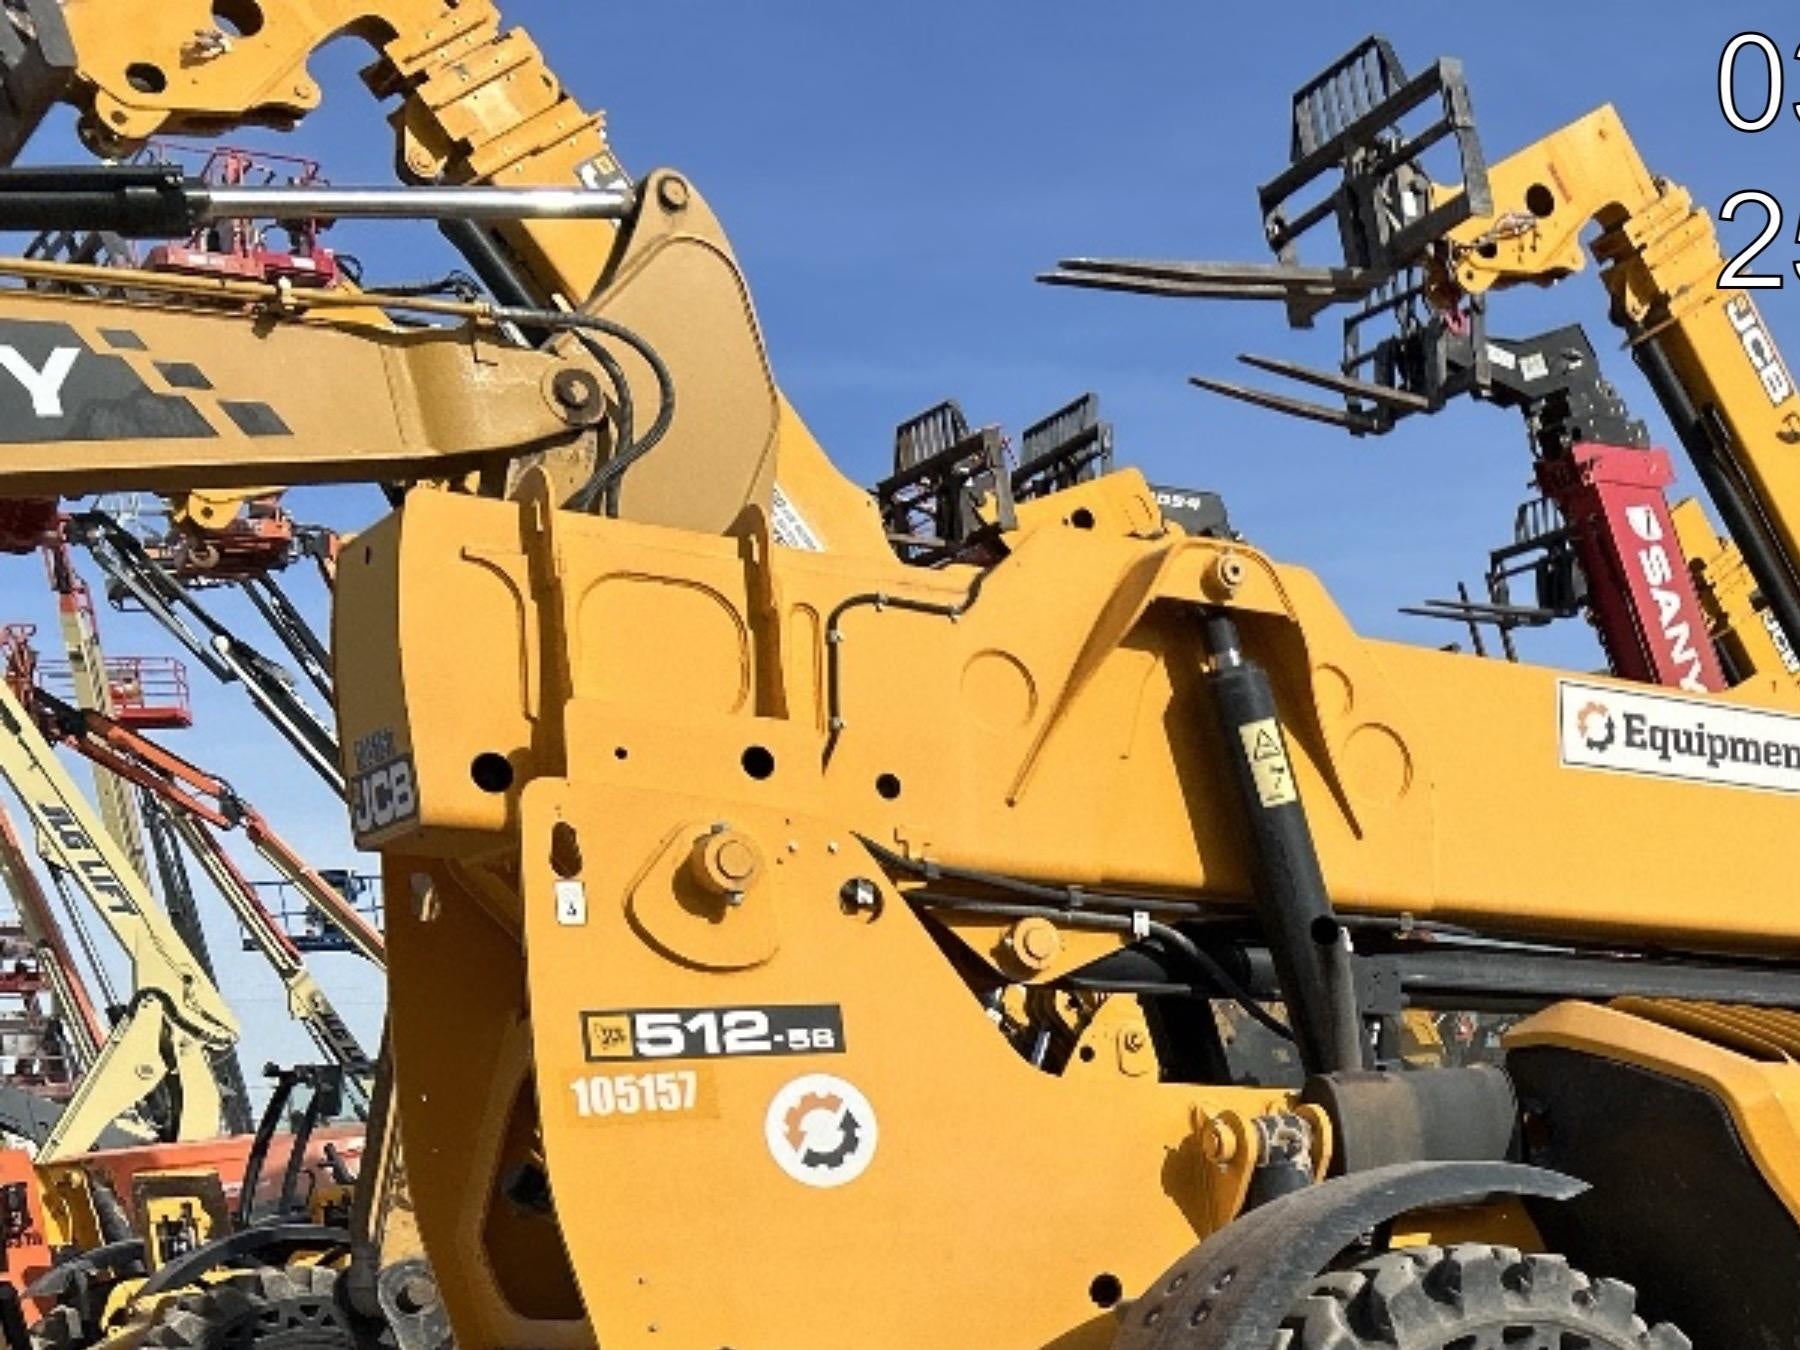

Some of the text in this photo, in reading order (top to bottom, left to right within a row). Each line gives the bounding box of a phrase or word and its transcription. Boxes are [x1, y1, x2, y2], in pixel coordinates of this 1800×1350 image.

[1727, 301, 1791, 406] JCB
[1636, 544, 1709, 694] SANY
[354, 760, 416, 832] JCB
[38, 802, 139, 915] JLG LIFT
[569, 1070, 698, 1117] 105157
